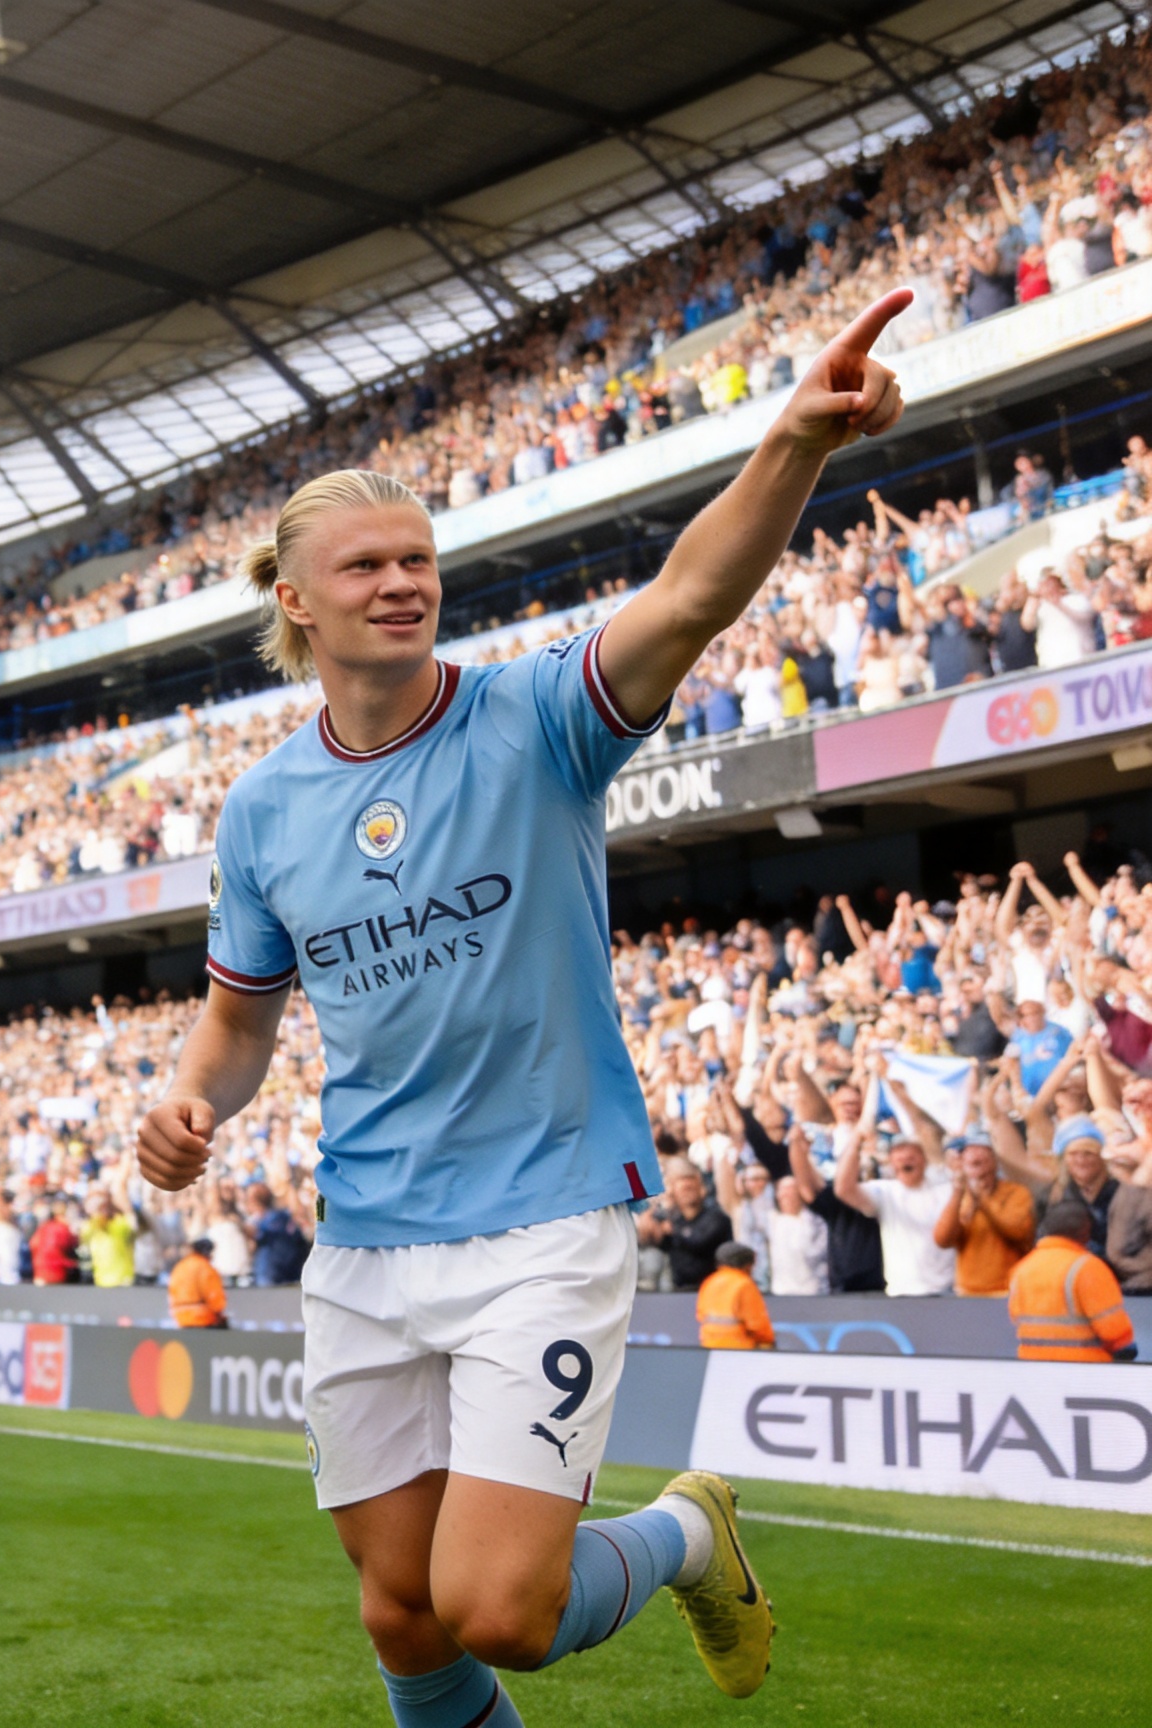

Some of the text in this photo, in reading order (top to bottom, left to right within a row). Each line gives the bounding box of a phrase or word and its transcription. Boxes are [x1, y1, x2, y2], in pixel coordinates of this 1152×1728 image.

[305, 873, 512, 968] ETIHAD
[342, 931, 484, 997] AIRWAYS
[541, 1339, 593, 1421] 9
[744, 1383, 1152, 1485] ETIHAD
